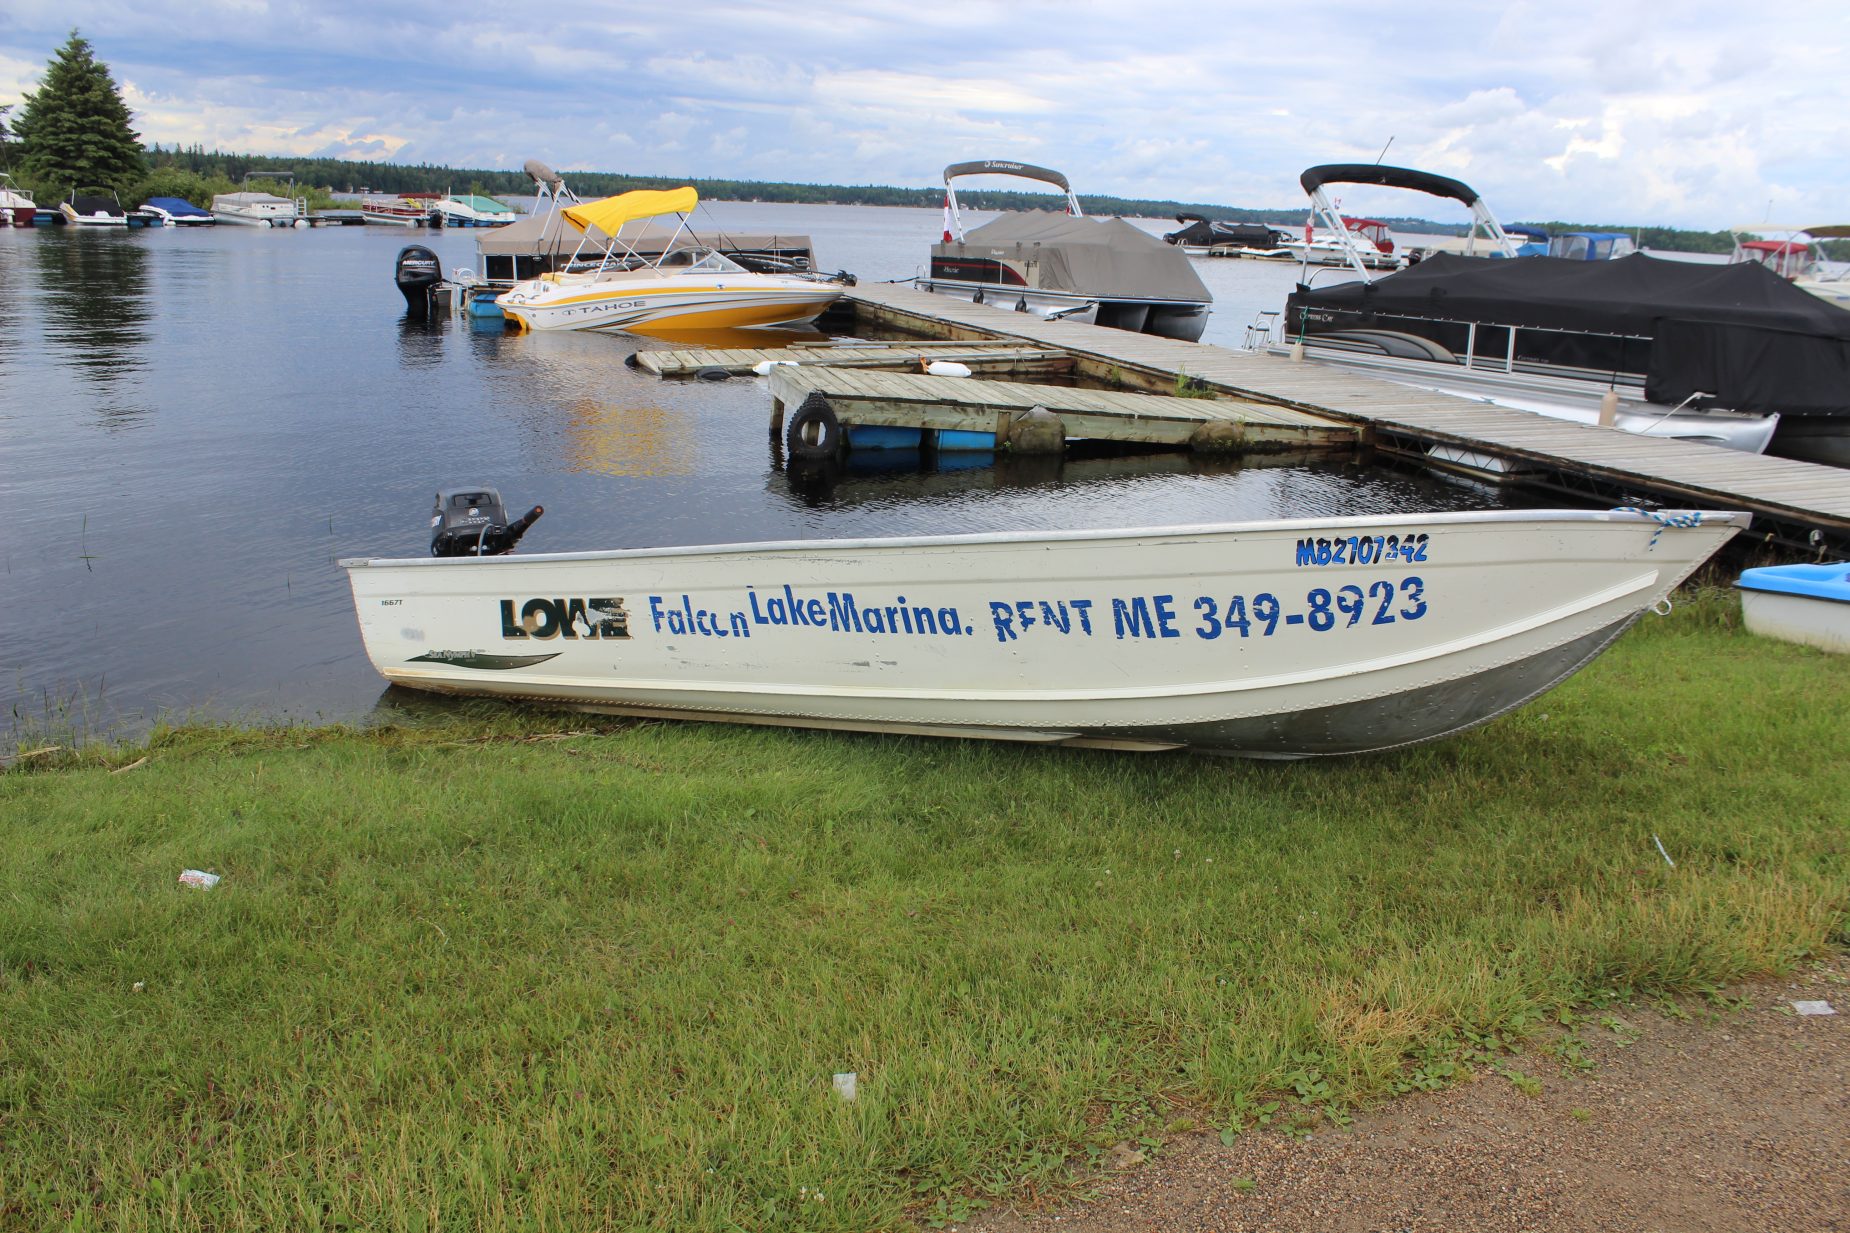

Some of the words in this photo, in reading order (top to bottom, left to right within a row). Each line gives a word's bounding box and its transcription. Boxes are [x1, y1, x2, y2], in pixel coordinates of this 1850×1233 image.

[579, 300, 646, 314] TAHOE
[1111, 595, 1180, 639] ME
[1193, 576, 1428, 640] 349-8923
